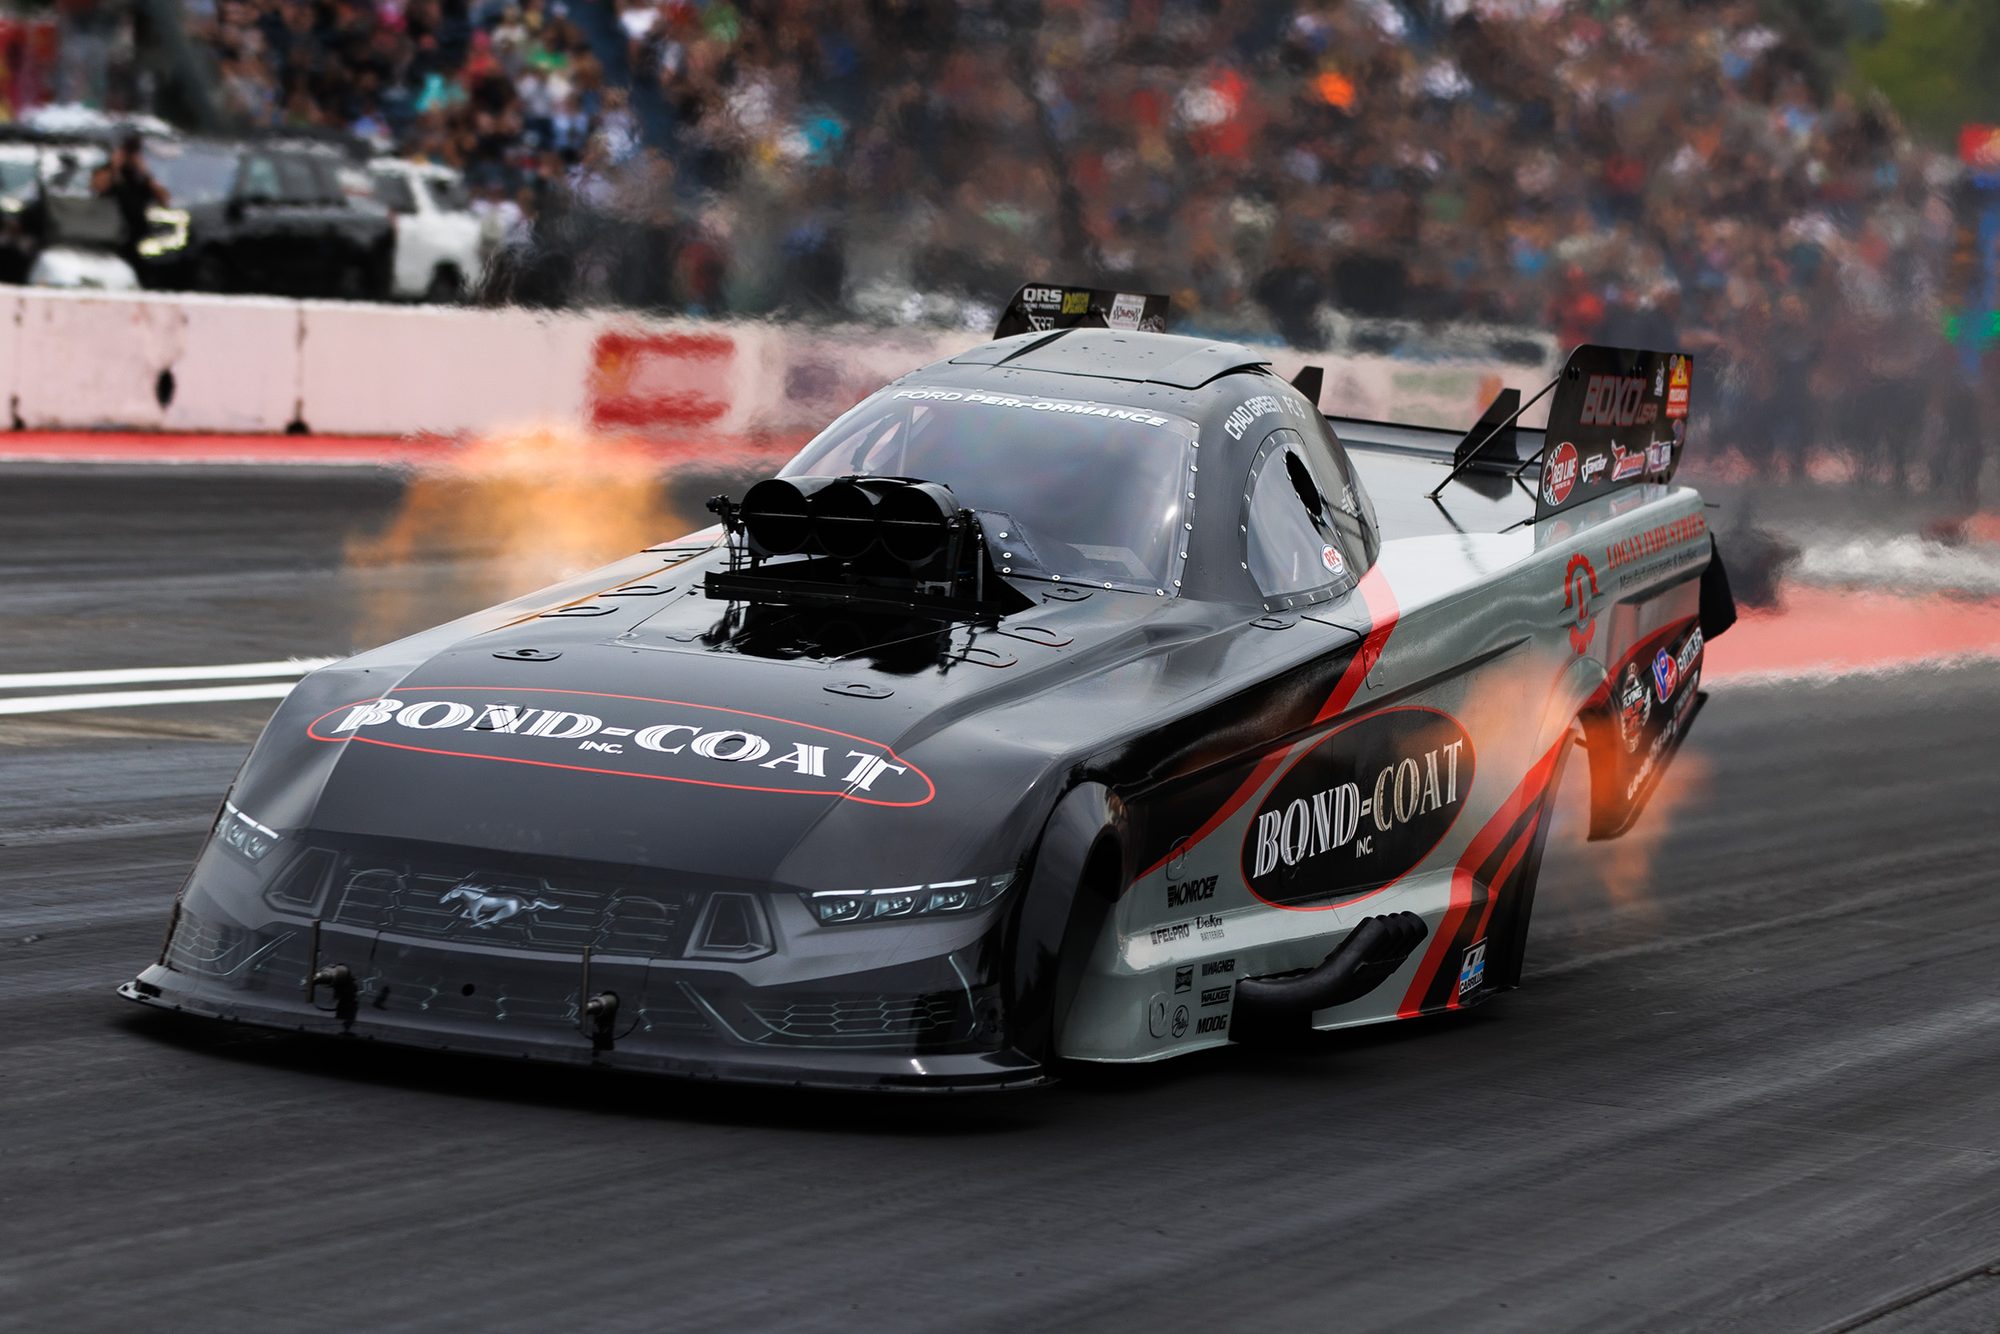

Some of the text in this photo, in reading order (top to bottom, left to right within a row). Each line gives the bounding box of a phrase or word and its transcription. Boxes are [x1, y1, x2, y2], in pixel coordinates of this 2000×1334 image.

[1023, 288, 1062, 303] QRS
[893, 390, 1169, 428] FORD PERFORMANCE
[1580, 374, 1647, 427] BOXO
[1224, 405, 1254, 441] CHAD
[1244, 395, 1284, 417] GREEN
[1552, 461, 1564, 485] RED
[1563, 457, 1577, 481] LINE
[1606, 534, 1644, 570] LOGAN
[1622, 685, 1643, 709] FLYING
[578, 740, 624, 755] INC.
[1174, 875, 1219, 907] MONROE
[1194, 914, 1223, 929] Deka
[1201, 929, 1225, 942] BATTERIES
[1207, 959, 1236, 976] WAGNER
[1201, 989, 1232, 1003] WALKER
[1195, 1014, 1228, 1036] MOOG
